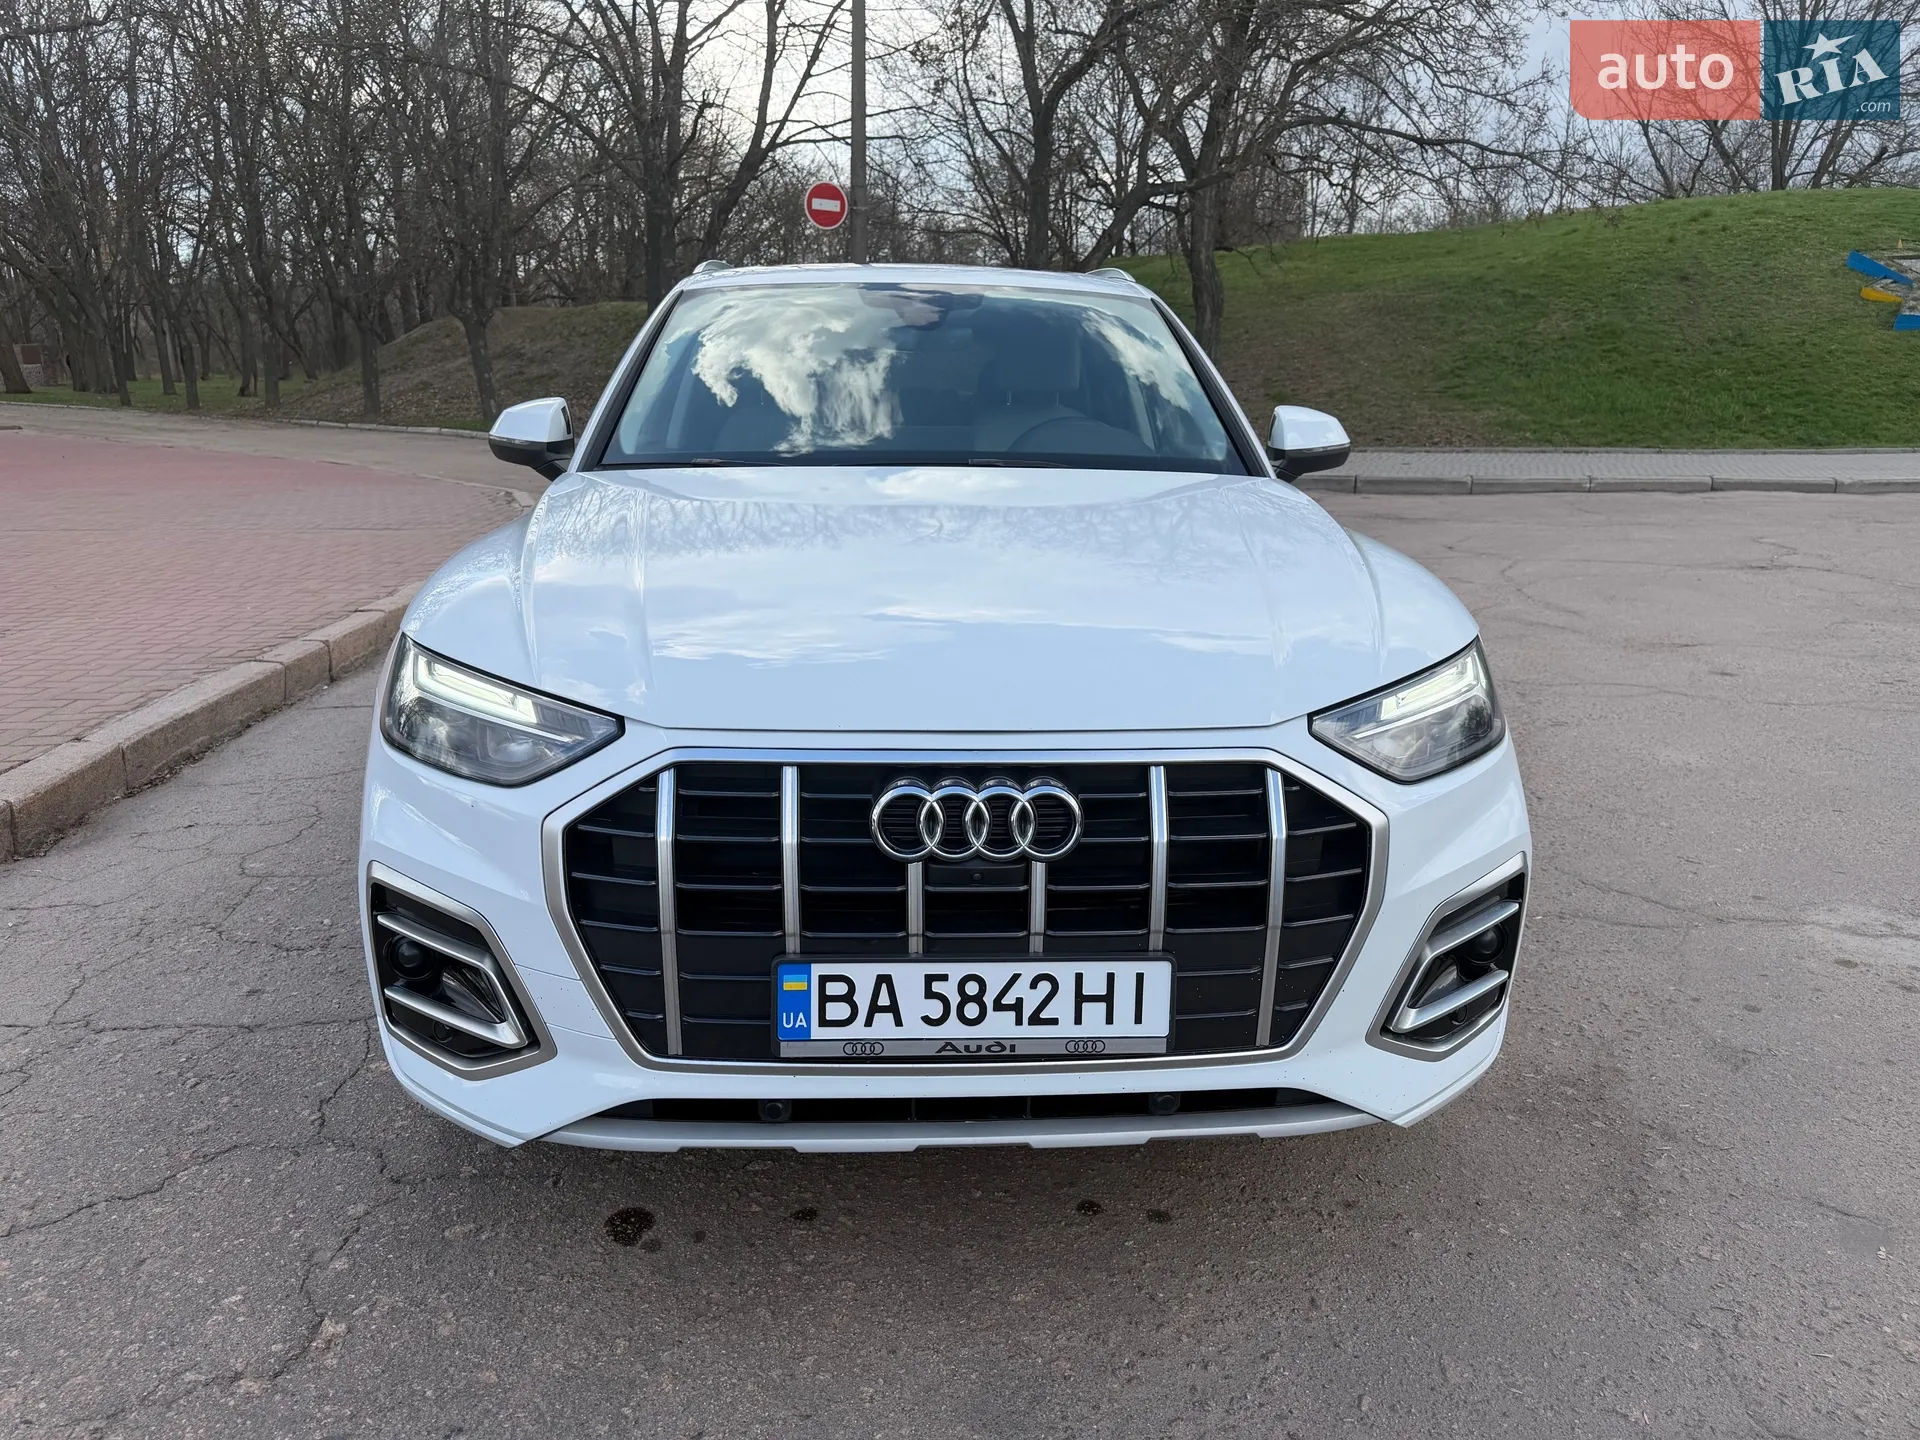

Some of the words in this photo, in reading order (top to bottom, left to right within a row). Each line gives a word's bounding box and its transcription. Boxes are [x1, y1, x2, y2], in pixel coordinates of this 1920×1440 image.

[817, 973, 904, 1028] BA
[920, 972, 1060, 1027] 5842
[1074, 972, 1145, 1026] HI
[782, 1012, 808, 1028] UA
[935, 1041, 1017, 1054] Audi
